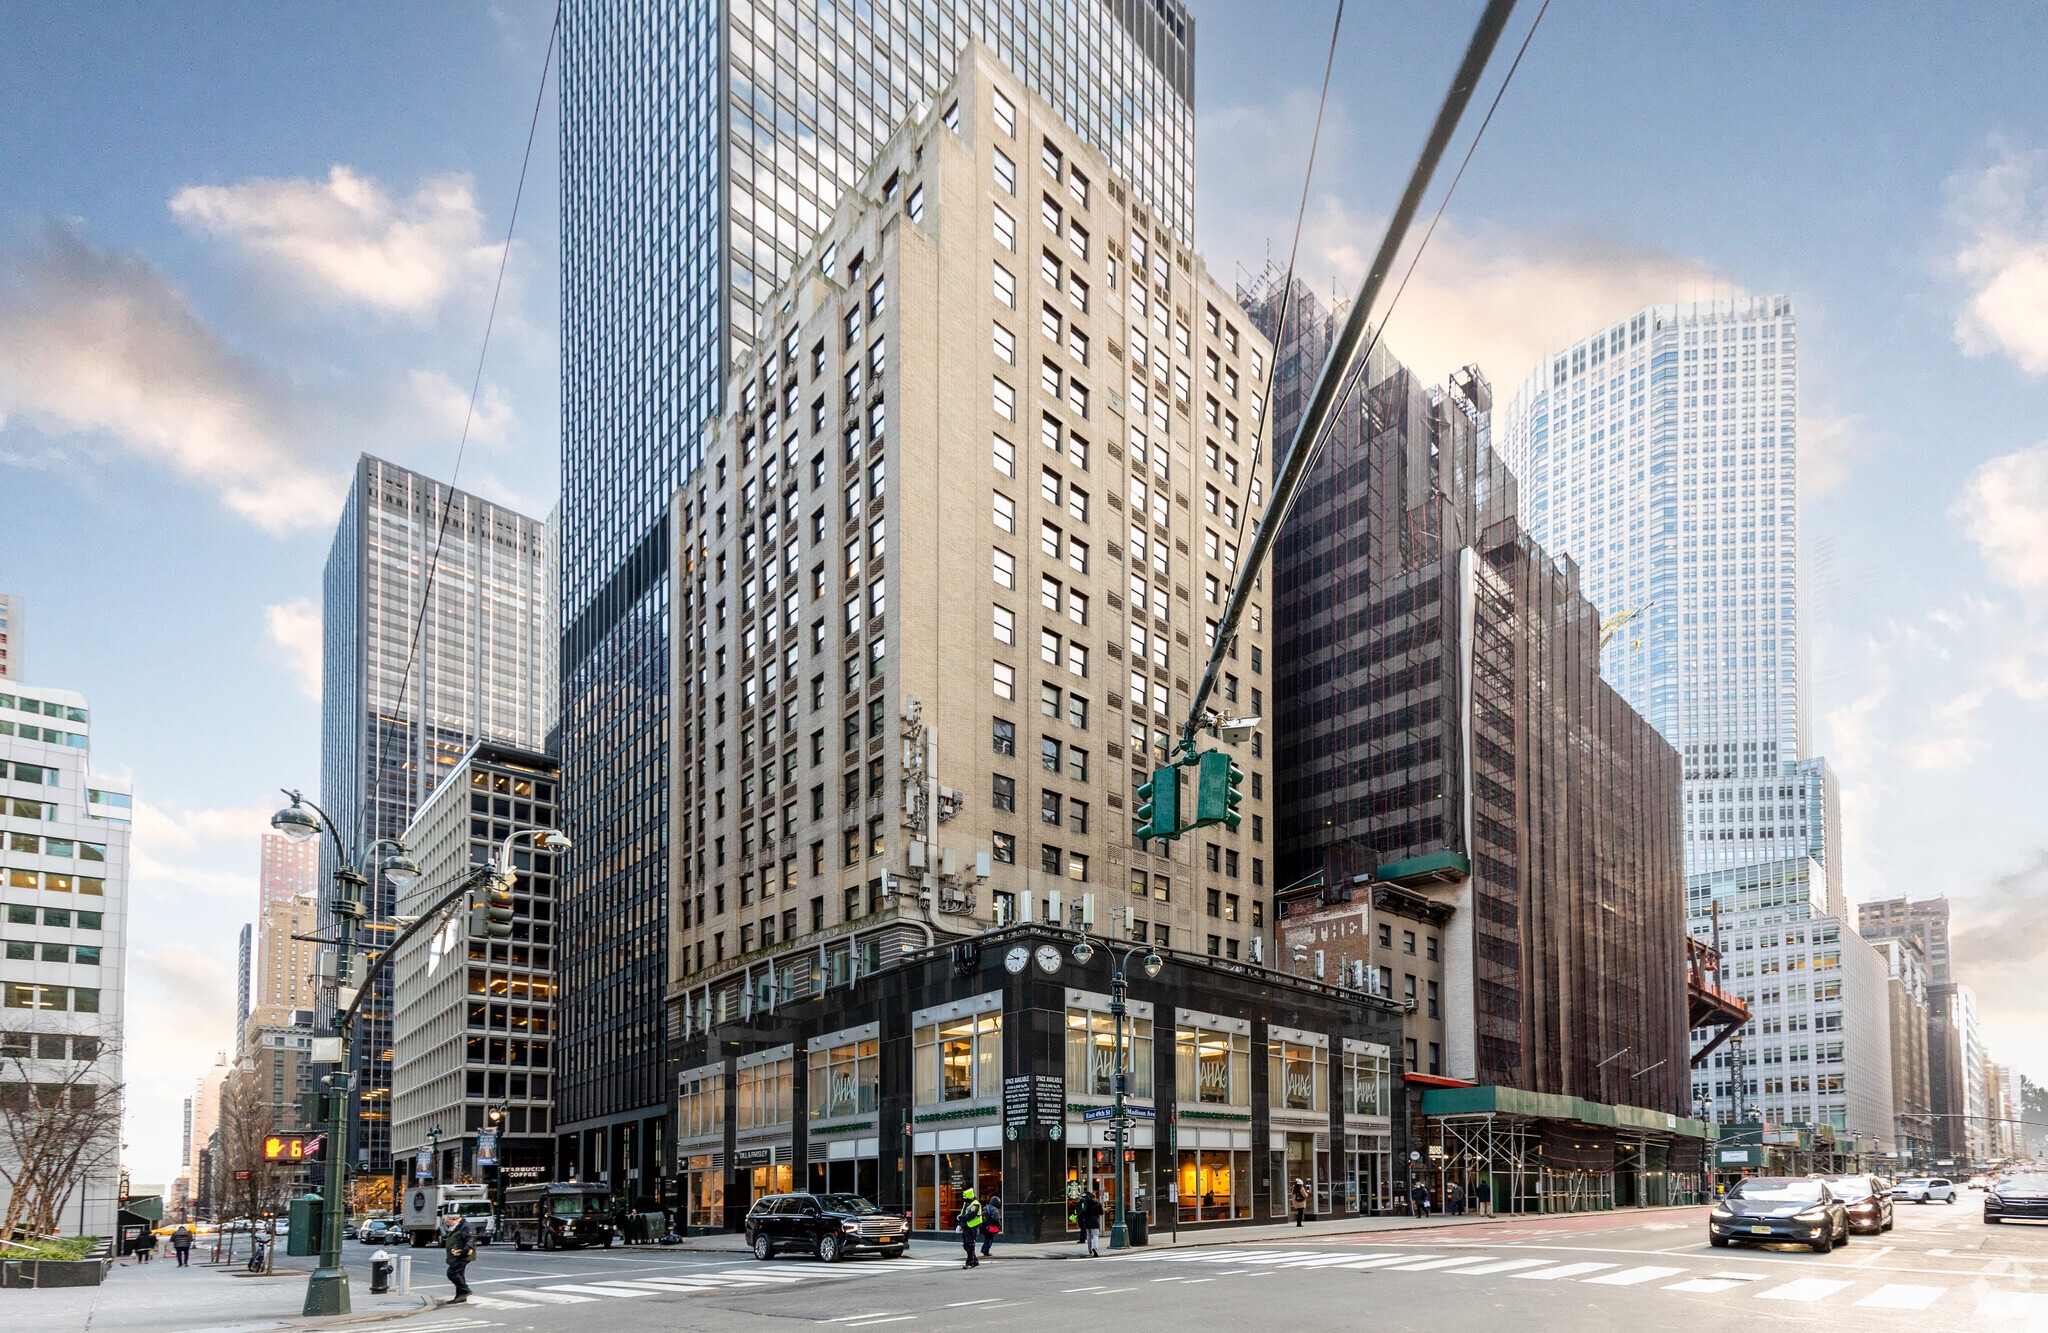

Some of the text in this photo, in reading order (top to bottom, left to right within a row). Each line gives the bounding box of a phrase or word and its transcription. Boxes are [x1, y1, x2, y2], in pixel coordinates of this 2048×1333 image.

[1200, 1062, 1228, 1089] AHAG
[1126, 1108, 1146, 1117] Madison
[291, 1140, 302, 1157] 6
